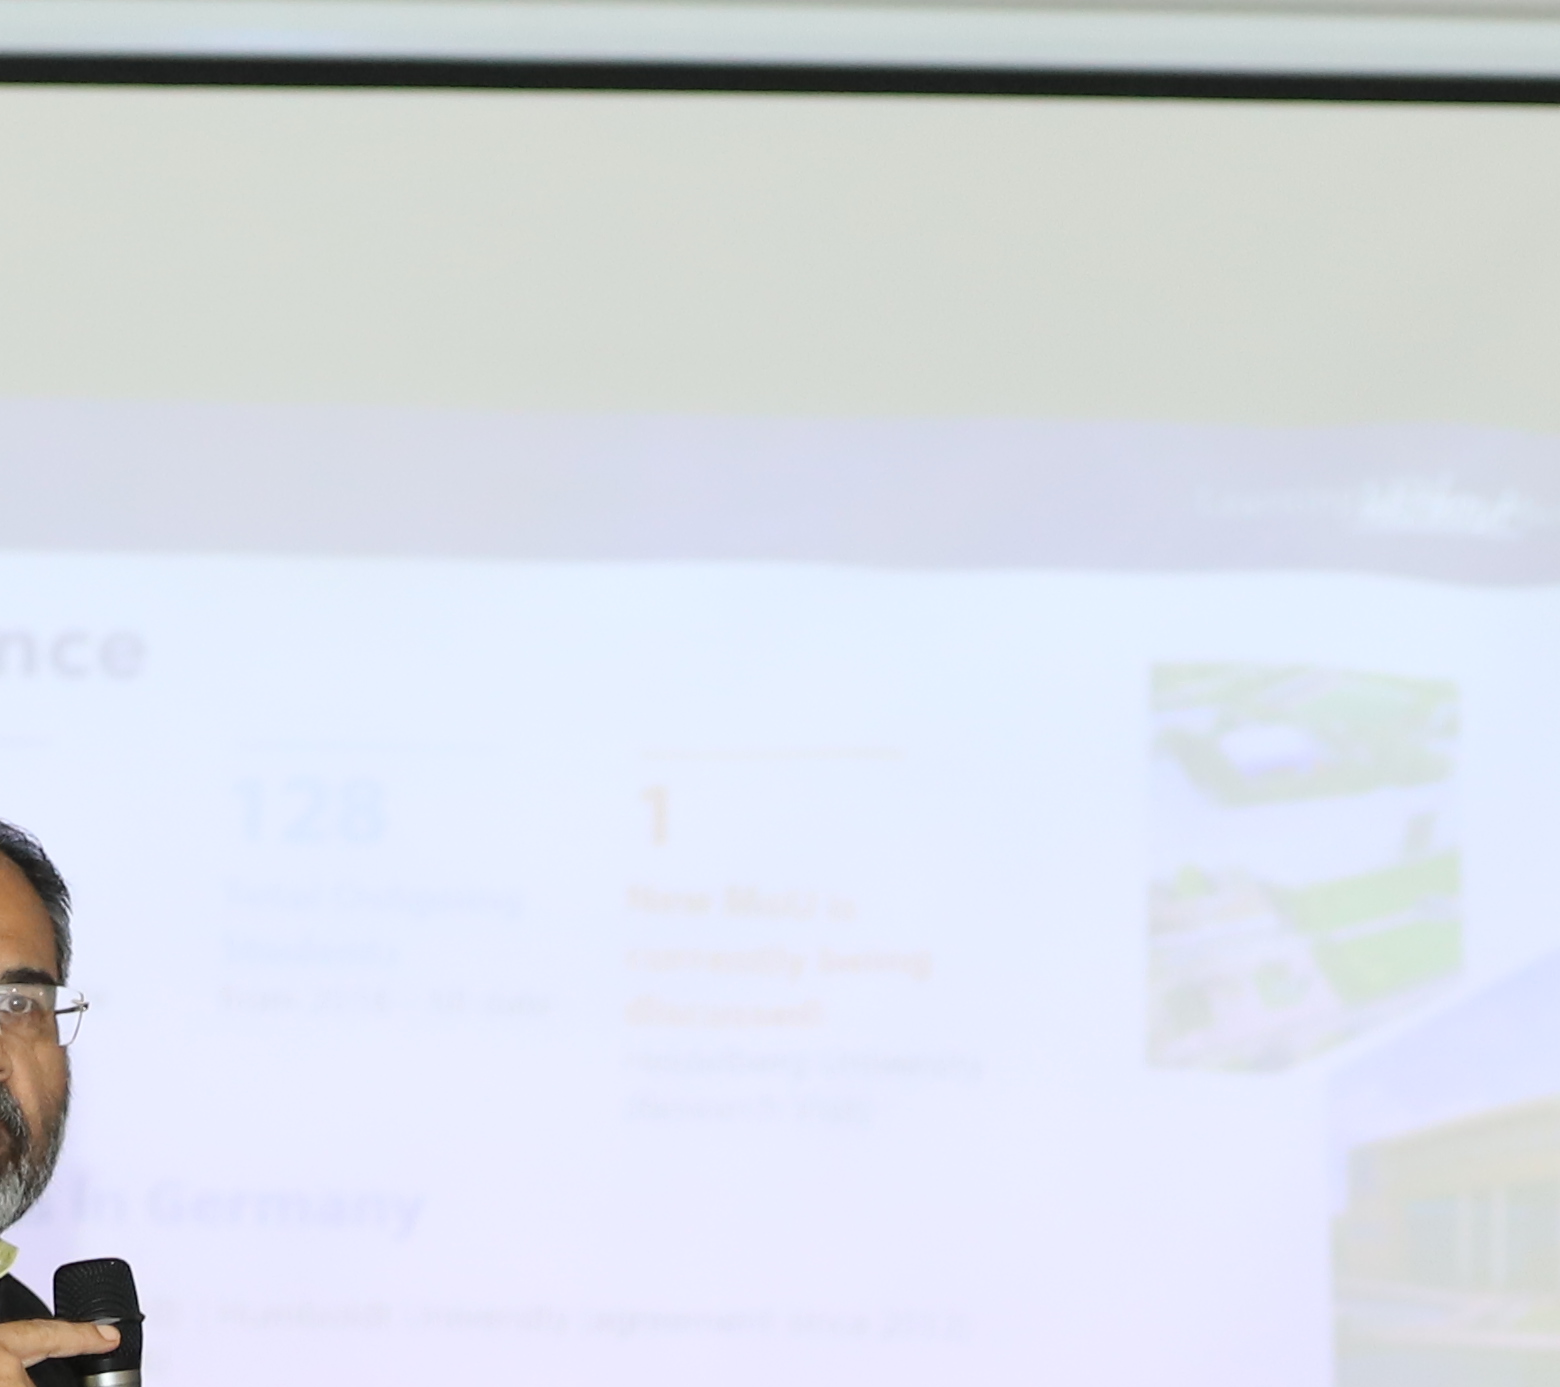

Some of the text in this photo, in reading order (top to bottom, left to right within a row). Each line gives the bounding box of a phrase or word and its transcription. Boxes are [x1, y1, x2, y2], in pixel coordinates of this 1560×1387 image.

[231, 773, 389, 844] 128
[640, 783, 671, 848] 1
[146, 1177, 428, 1242] Germany
